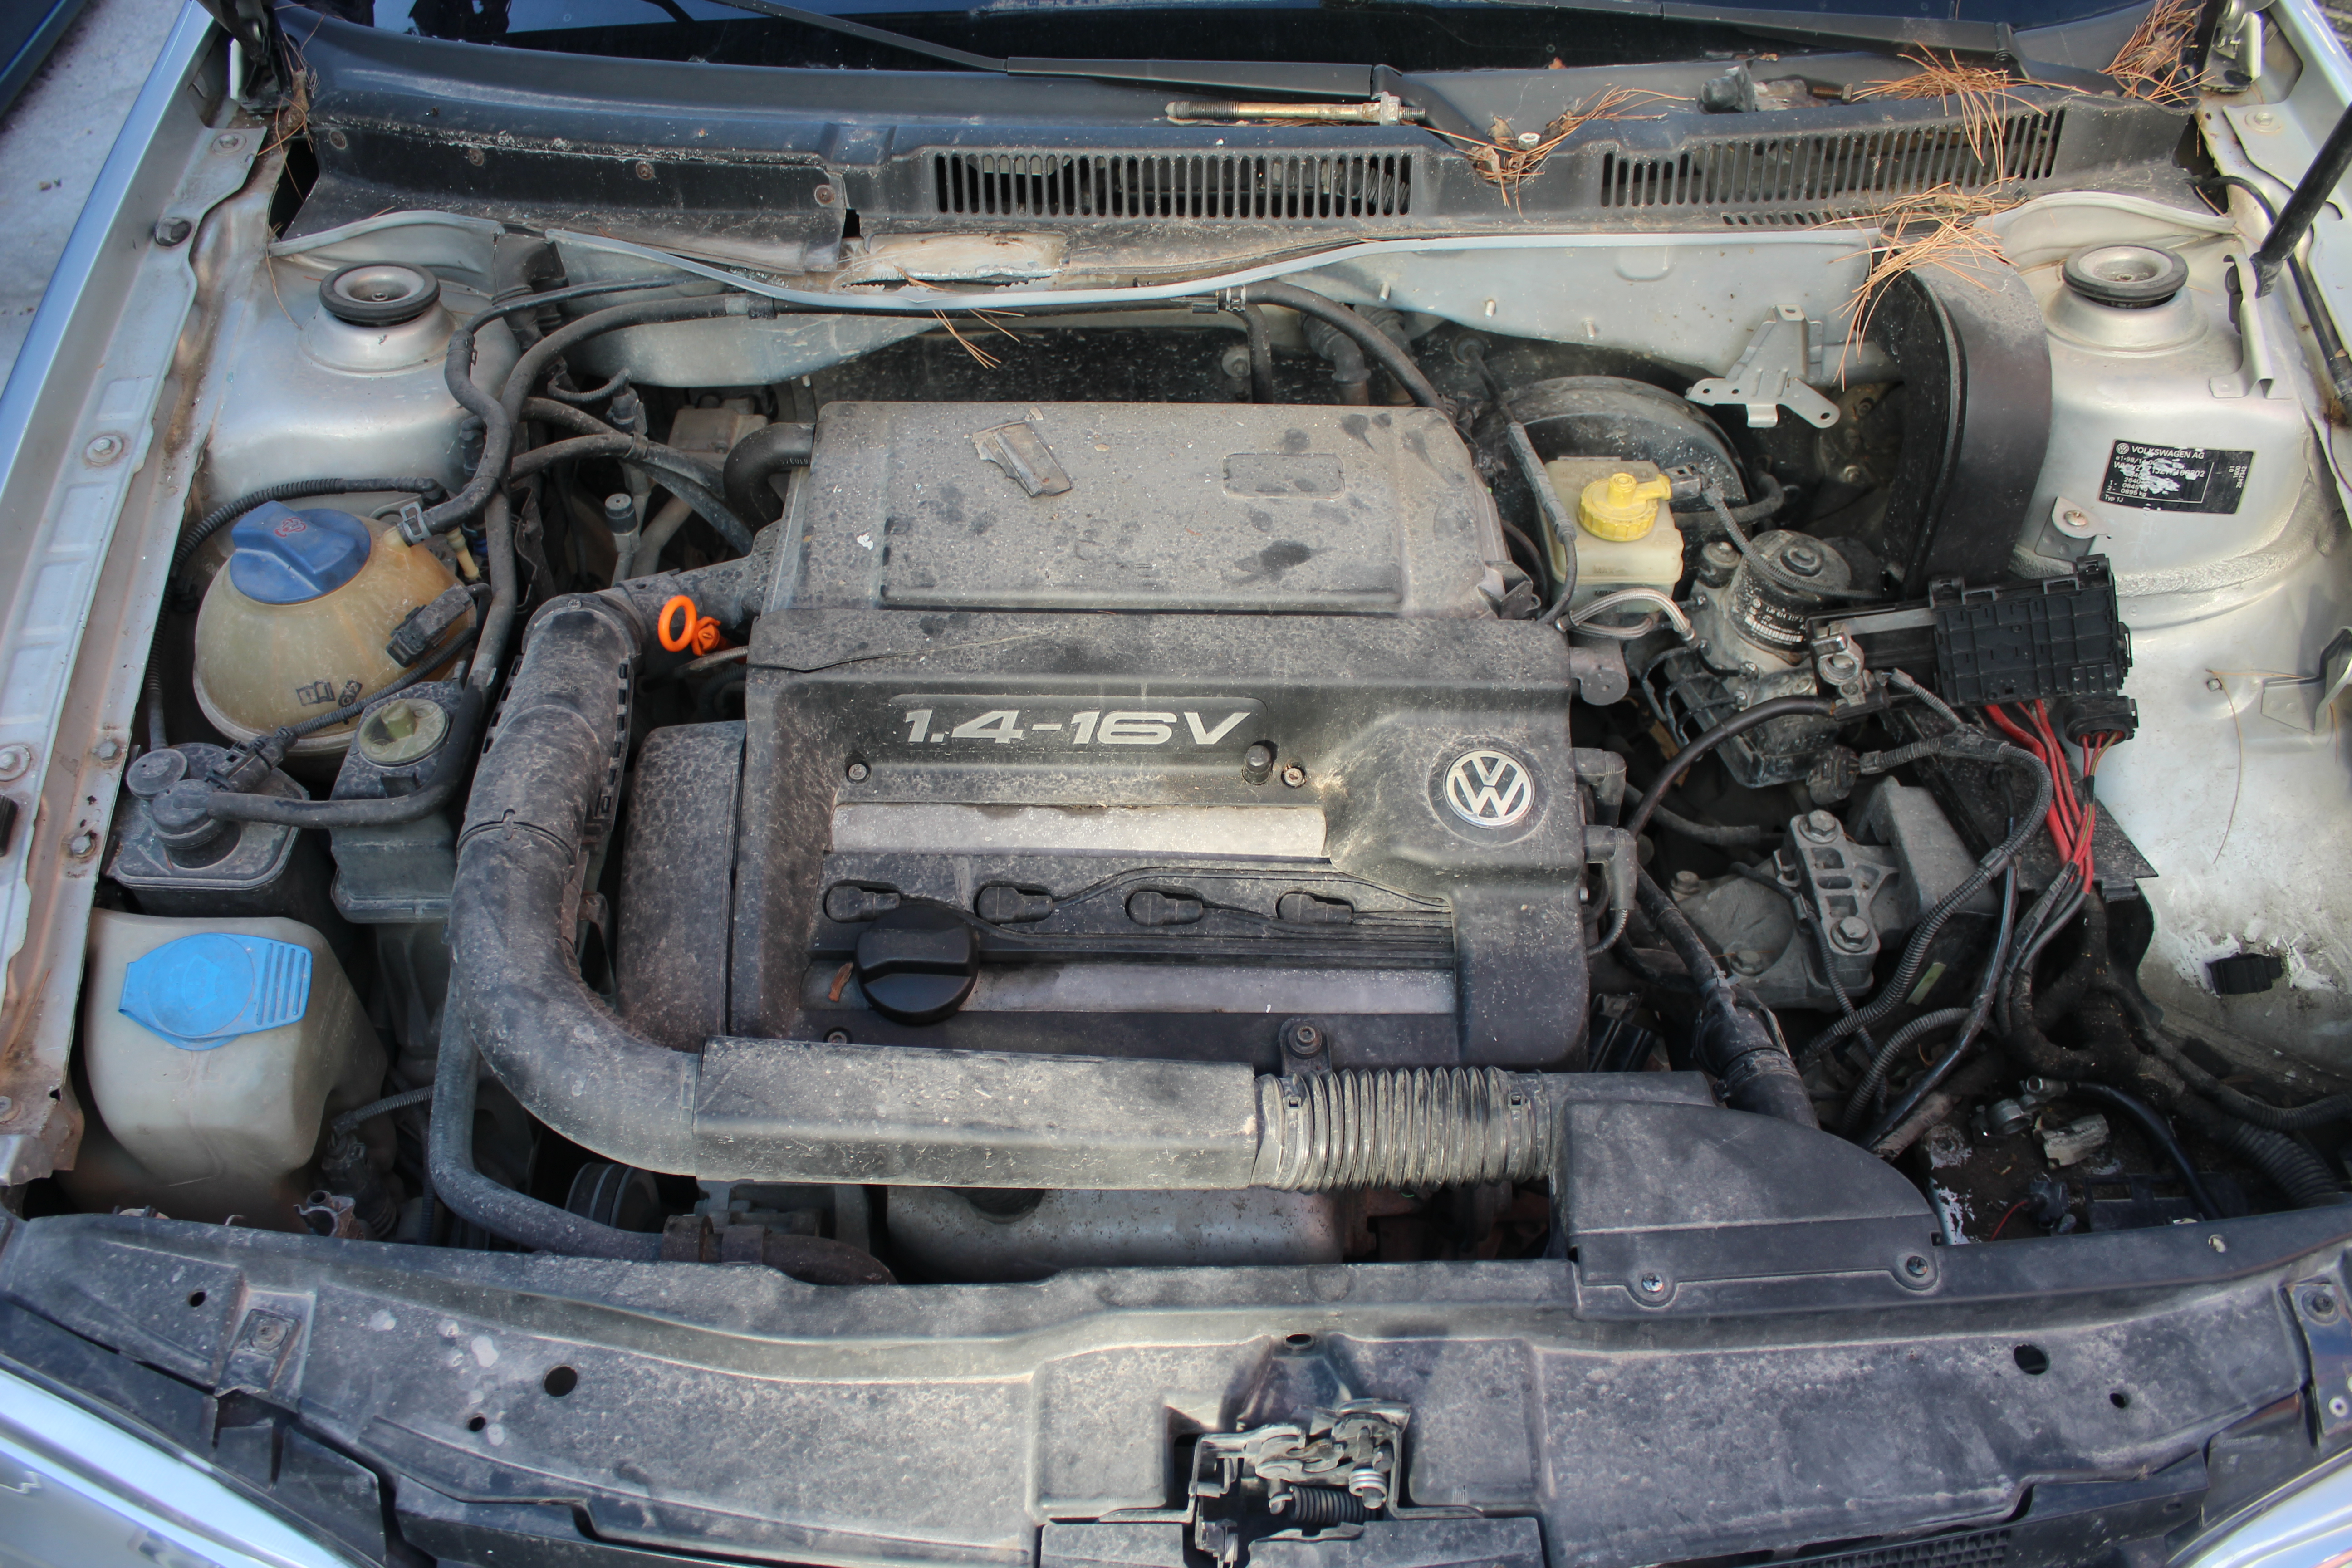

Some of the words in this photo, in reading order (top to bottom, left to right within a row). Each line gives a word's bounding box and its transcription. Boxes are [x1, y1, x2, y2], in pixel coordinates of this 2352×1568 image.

[2132, 446, 2191, 459] VOLKSWAGEN
[2105, 494, 2116, 502] Typ
[905, 709, 1251, 745] 1.4-16V
